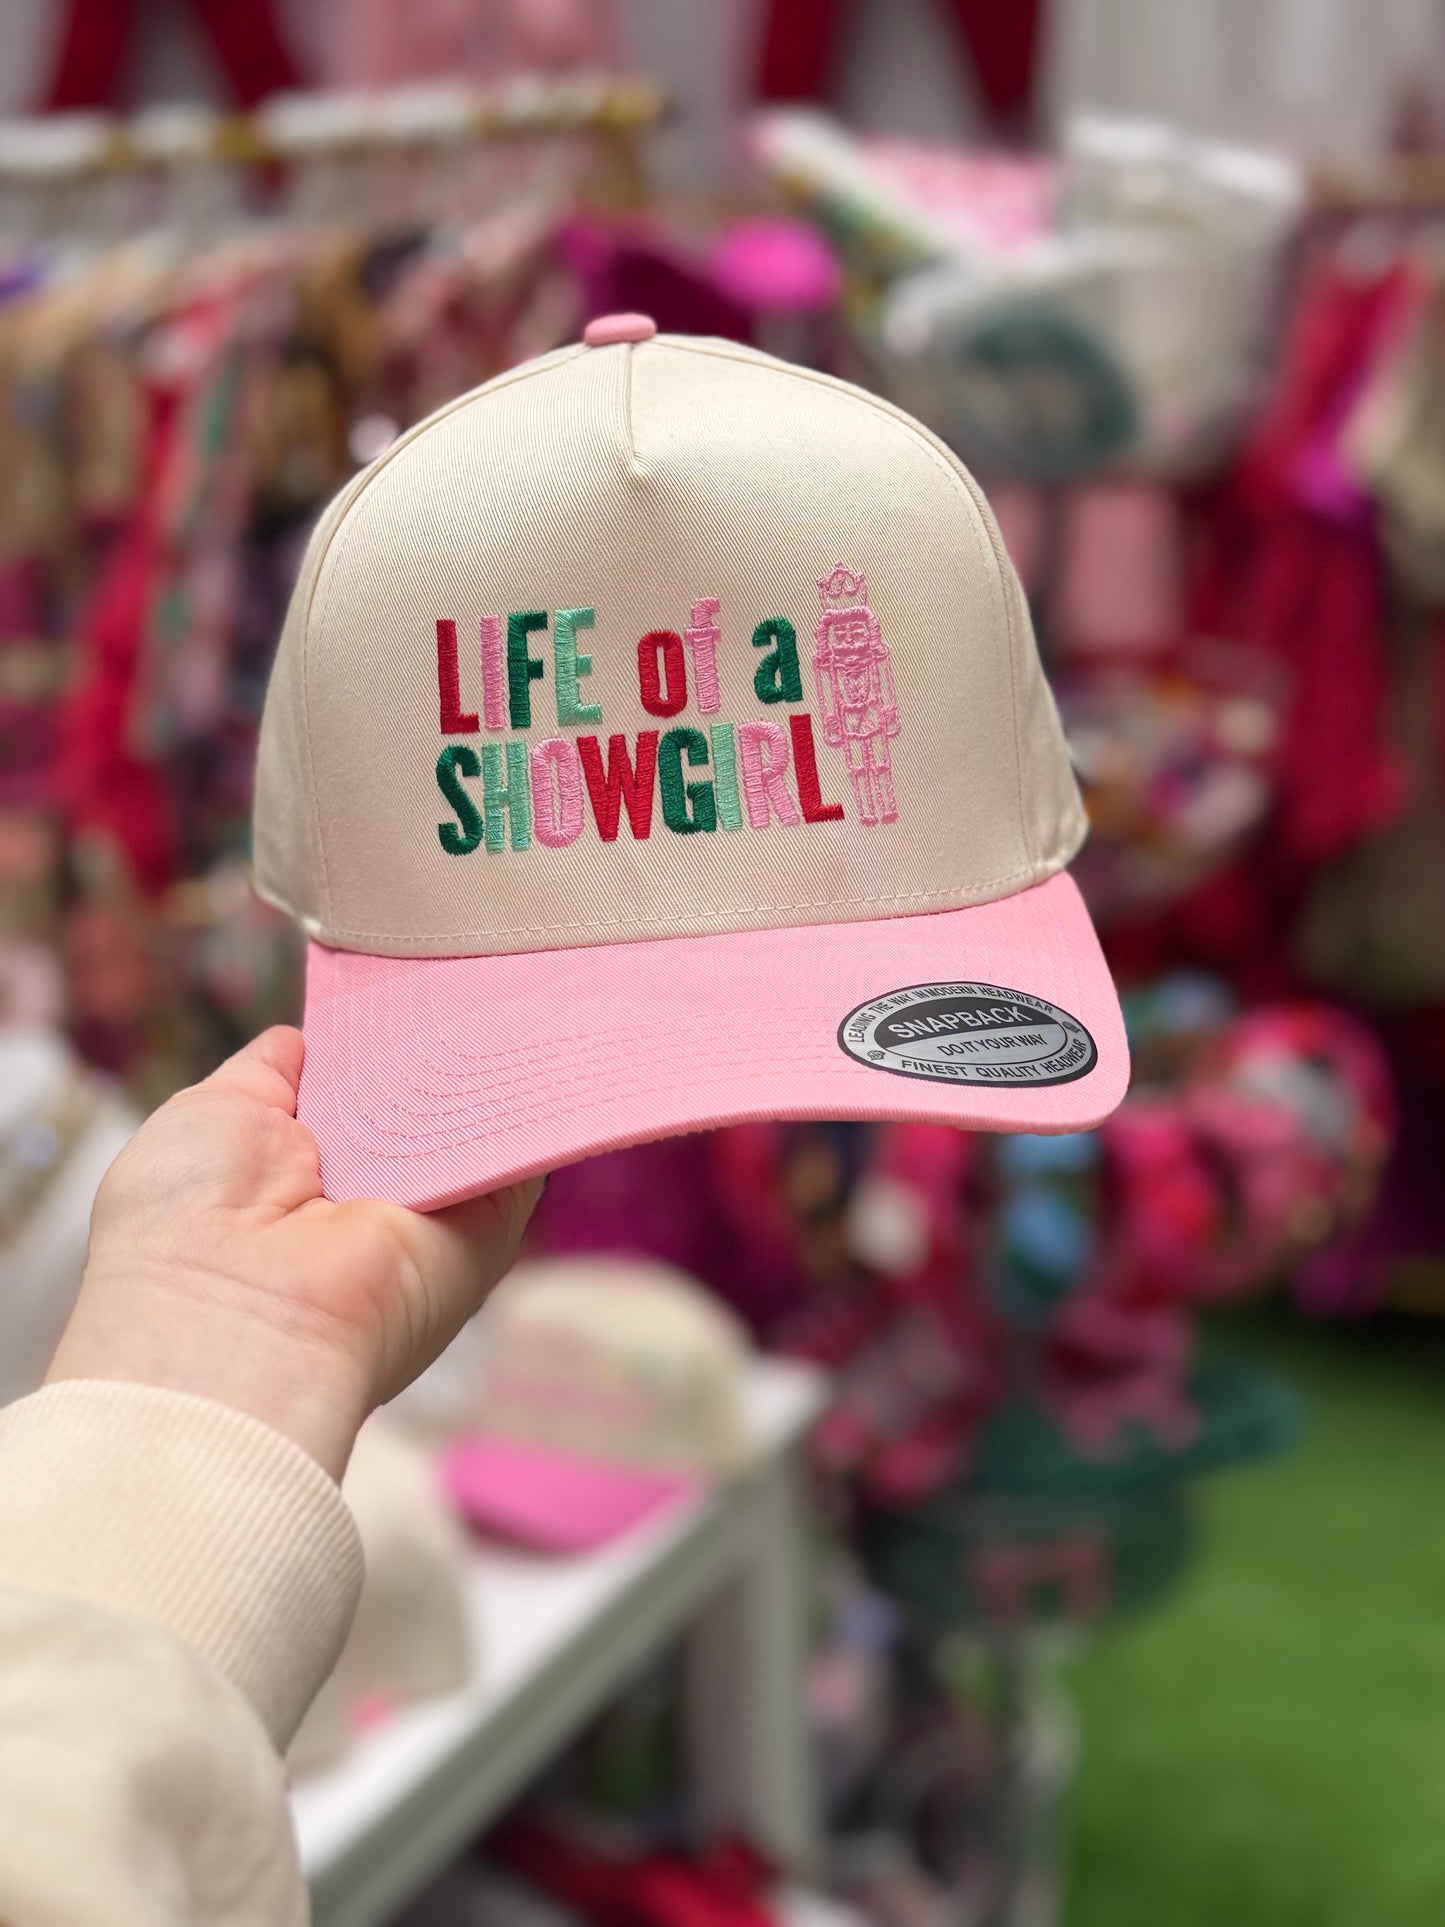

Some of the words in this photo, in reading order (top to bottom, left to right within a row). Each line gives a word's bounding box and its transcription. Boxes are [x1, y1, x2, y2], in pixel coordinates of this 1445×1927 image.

[437, 605, 603, 734] LIFE
[638, 596, 721, 718] of
[752, 616, 804, 704] a
[435, 714, 844, 856] SHOWGIRL
[848, 1012, 877, 1043] LEADING
[868, 1001, 894, 1017] THE
[888, 993, 915, 1007] WAY
[912, 987, 930, 999] IN
[926, 985, 977, 998] MODERN
[978, 985, 1053, 1014] HEADWEAR
[888, 1005, 1033, 1039] SNAPBACK
[901, 1059, 969, 1077] FINEST
[975, 1063, 1042, 1079] QUALITY
[1040, 1038, 1087, 1074] HEADWEAR
[937, 1042, 965, 1056] DO
[960, 1040, 979, 1053] IT
[974, 1036, 1021, 1051] YOUR
[1015, 1033, 1048, 1047] WAY
